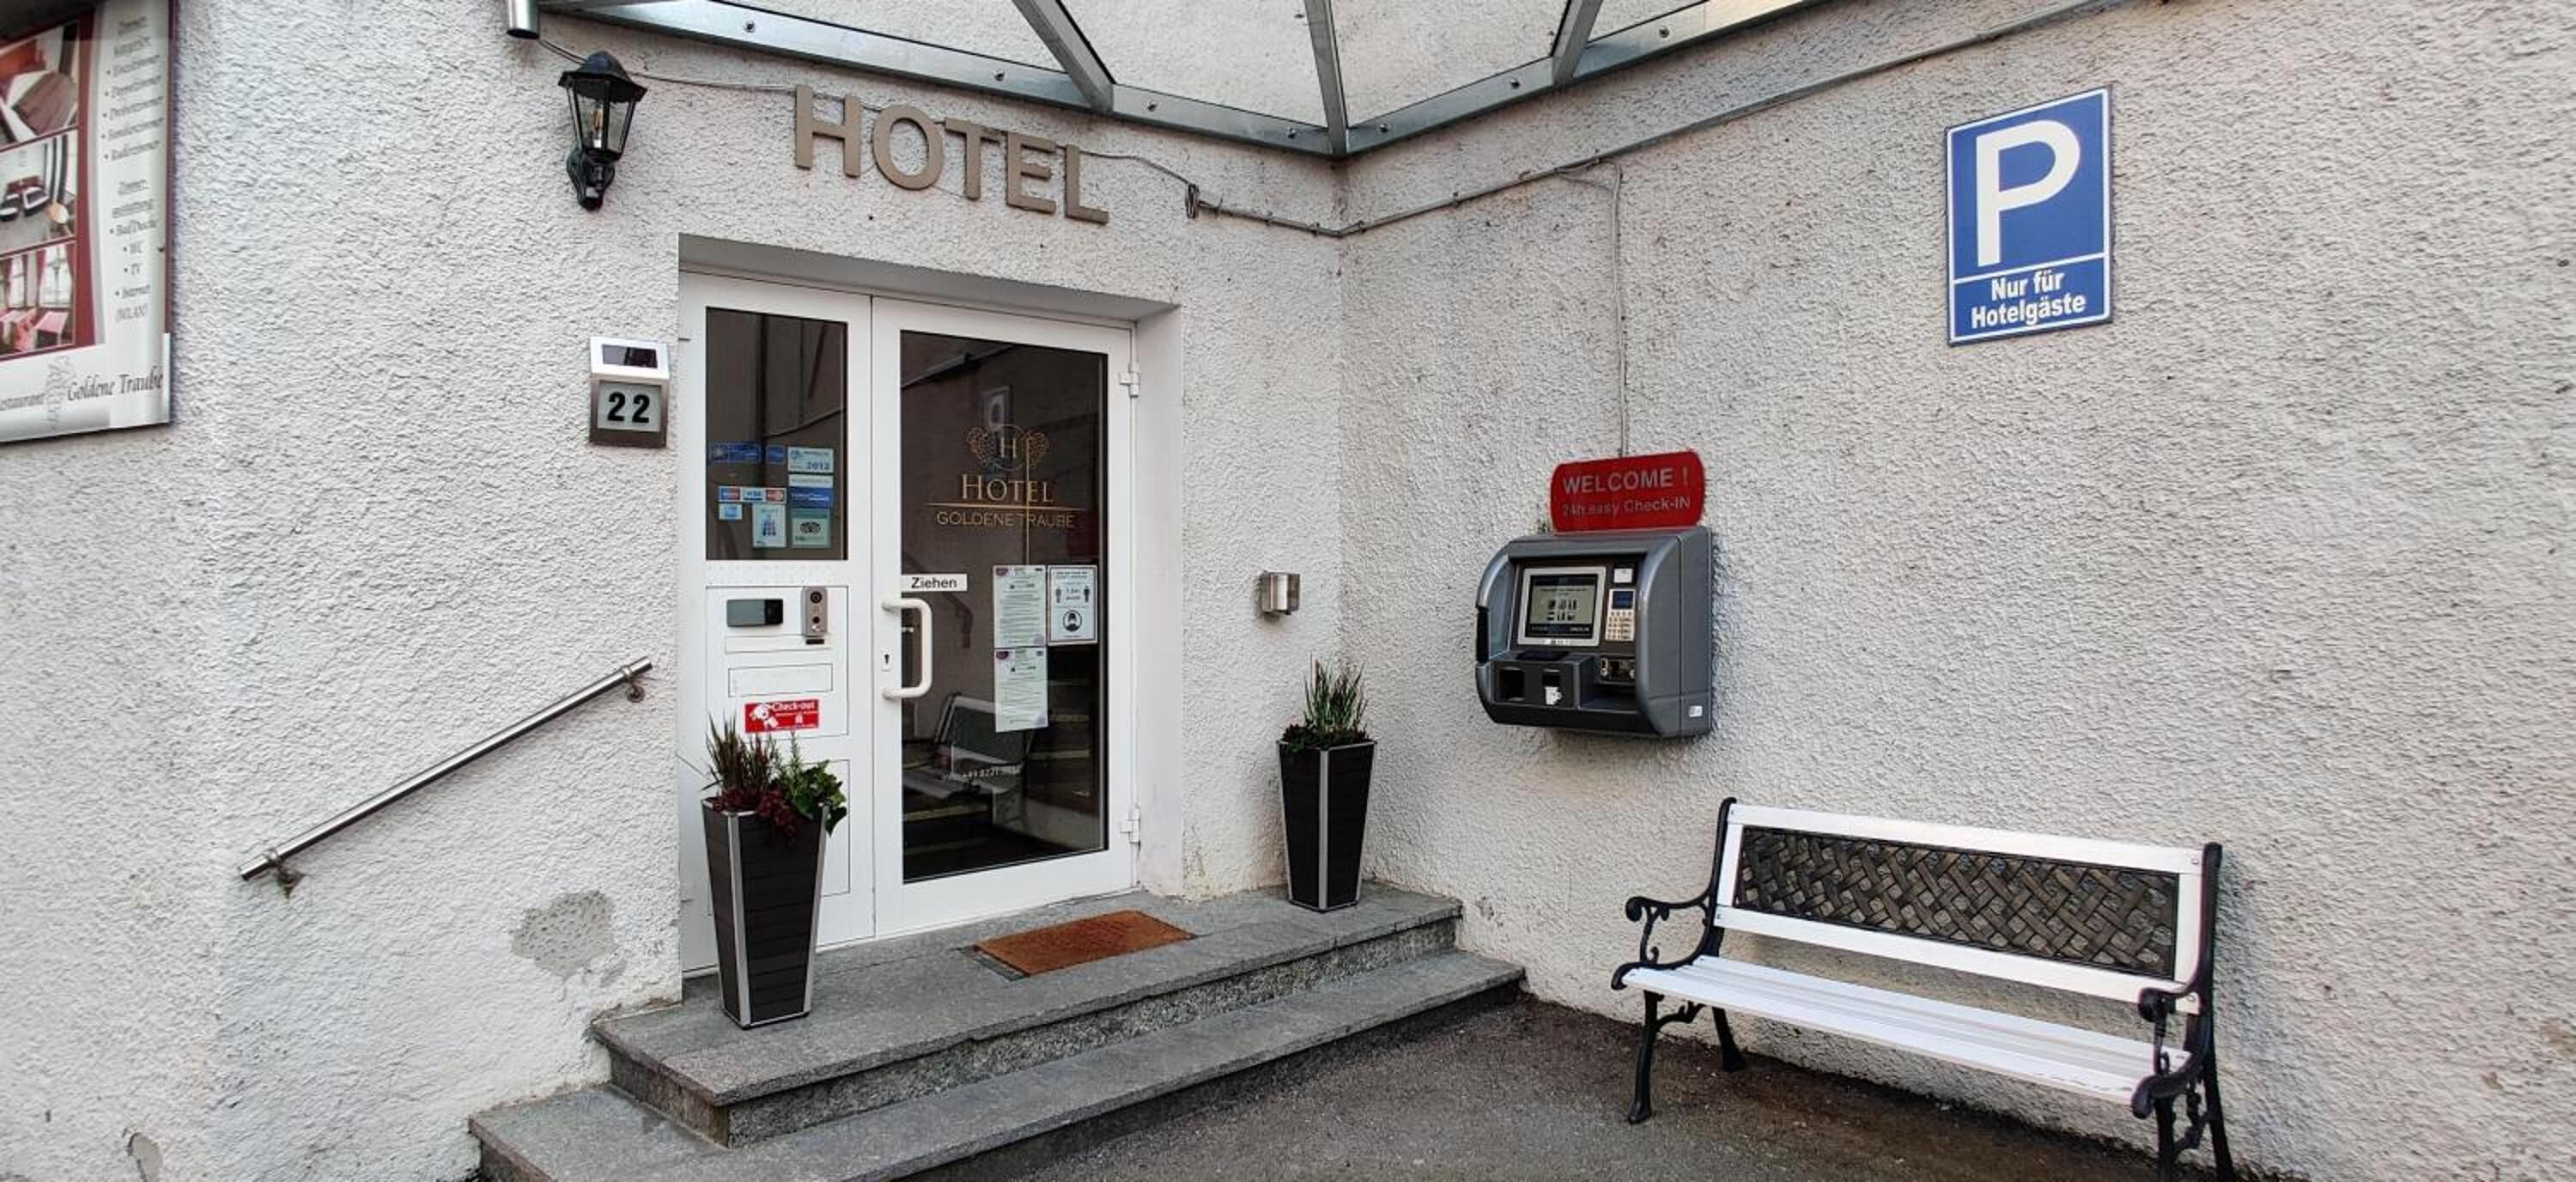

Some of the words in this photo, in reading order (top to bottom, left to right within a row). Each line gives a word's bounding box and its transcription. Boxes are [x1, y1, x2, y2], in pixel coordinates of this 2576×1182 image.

[795, 83, 1109, 225] HOTEL
[1976, 119, 2081, 267] P
[1991, 277, 2028, 302] Nur
[2033, 269, 2065, 294] für
[1971, 292, 2087, 329] Hotelgäste
[68, 375, 115, 401] Goldene
[118, 365, 164, 394] Traube
[607, 392, 650, 423] 22
[961, 473, 1054, 503] HOTEL
[1563, 467, 1674, 495] WELCOME
[937, 511, 1015, 527] GOLDENE
[1624, 496, 1691, 513] Check-IN
[911, 576, 957, 588] Ziehen
